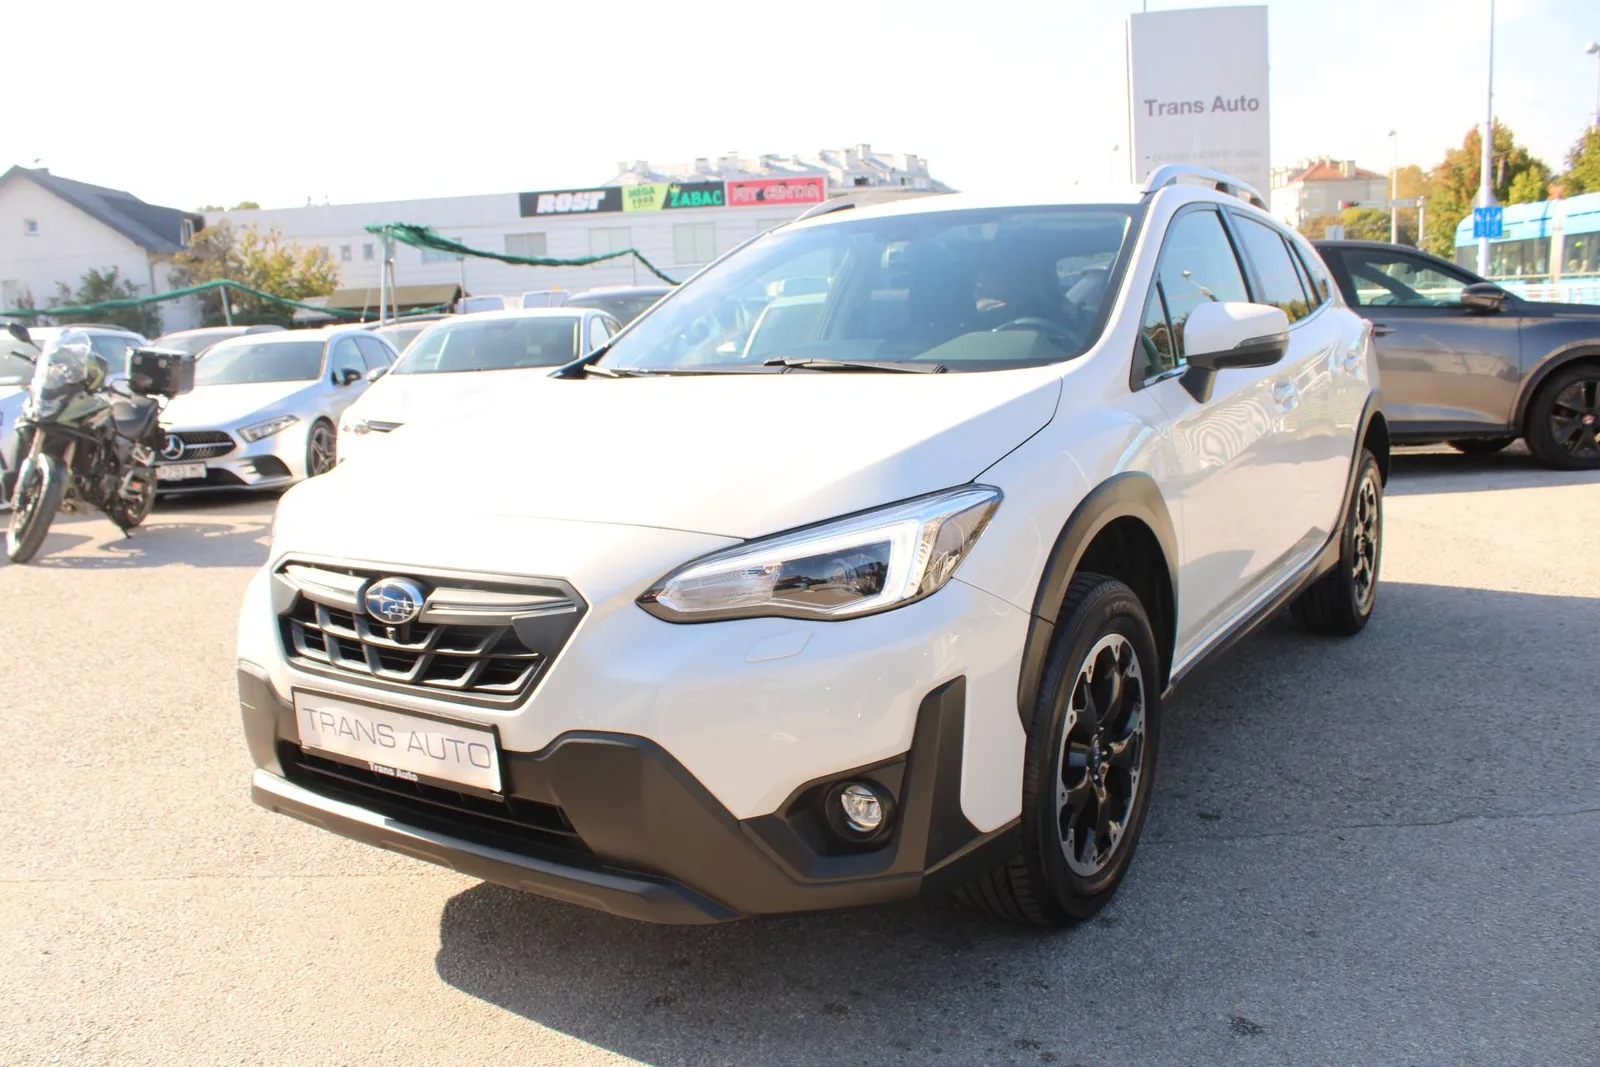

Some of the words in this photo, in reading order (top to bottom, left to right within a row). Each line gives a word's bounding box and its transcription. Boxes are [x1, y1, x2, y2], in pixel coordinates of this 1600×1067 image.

[1144, 98, 1205, 117] Trans
[1211, 94, 1260, 113] Auto
[536, 190, 607, 214] ROST
[302, 707, 396, 749] TRANS
[406, 730, 492, 770] AUTO
[368, 761, 395, 776] Trans
[396, 768, 419, 782] Auto
